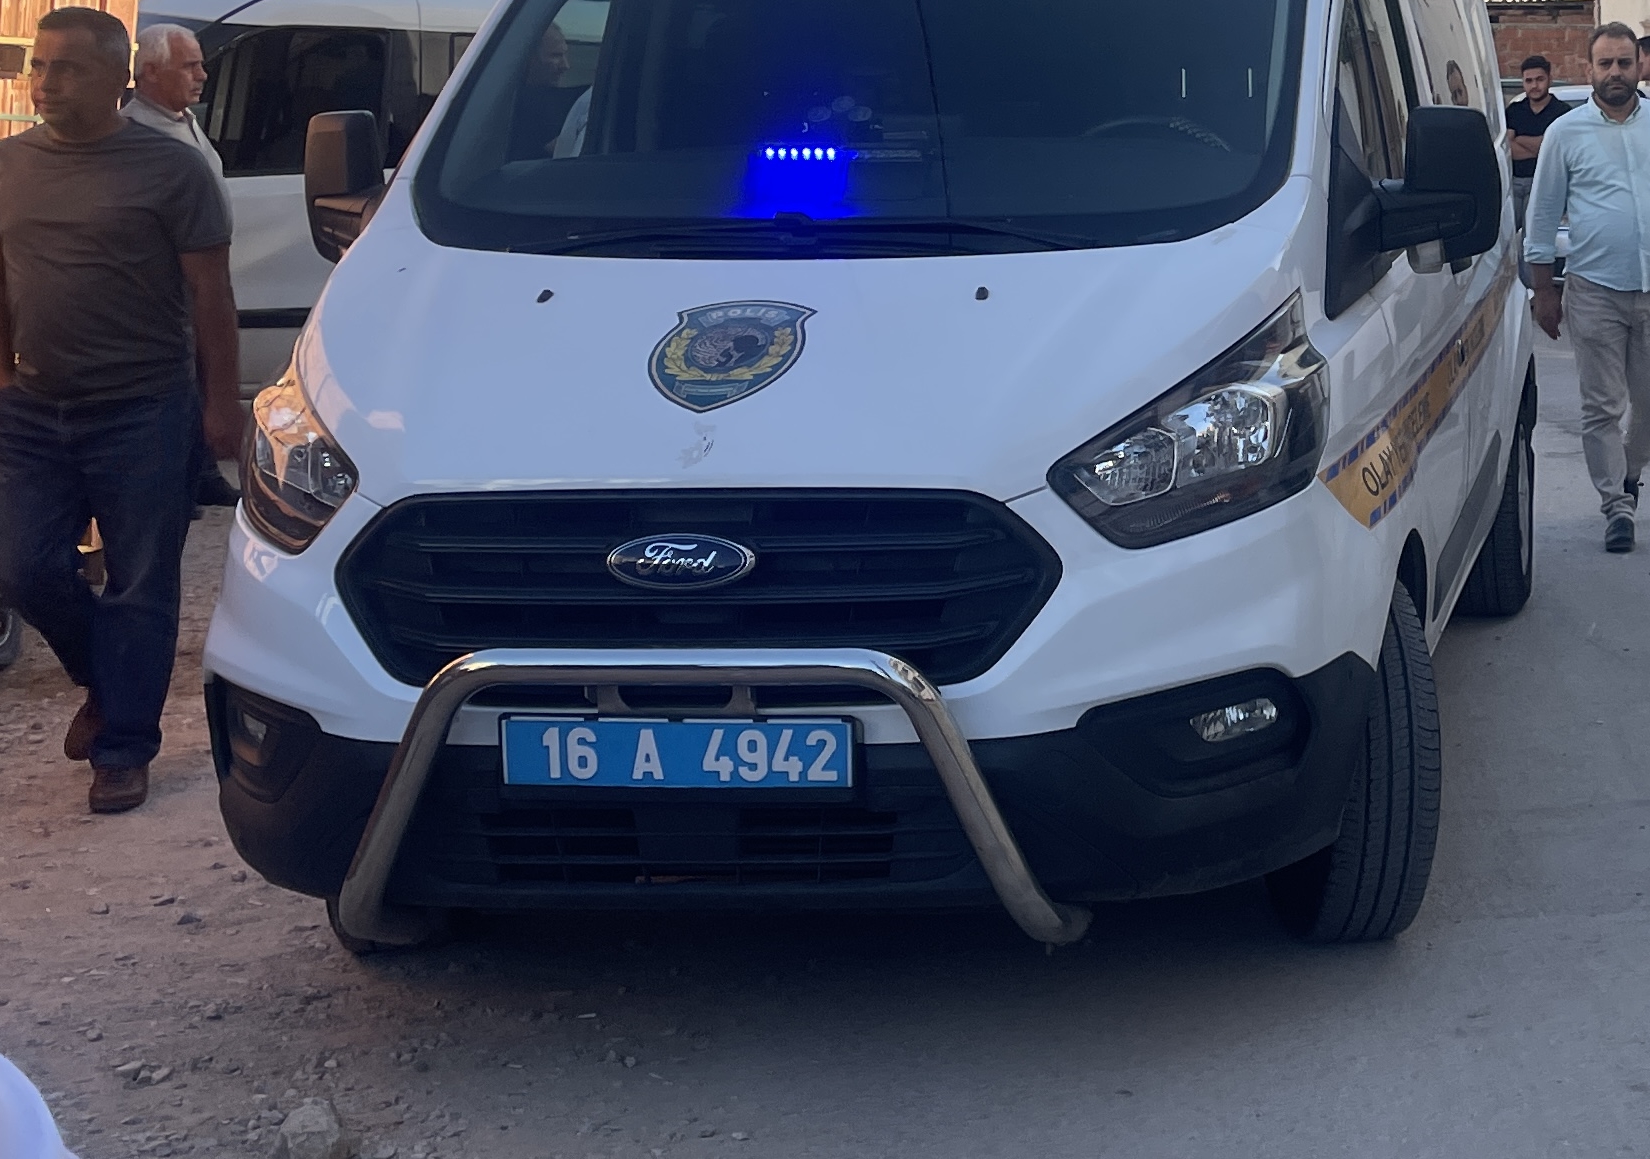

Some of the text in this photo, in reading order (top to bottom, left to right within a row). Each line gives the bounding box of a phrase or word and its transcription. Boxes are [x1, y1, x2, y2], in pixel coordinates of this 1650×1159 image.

[635, 542, 717, 576] Ford
[542, 726, 839, 782] 16 A 4942
